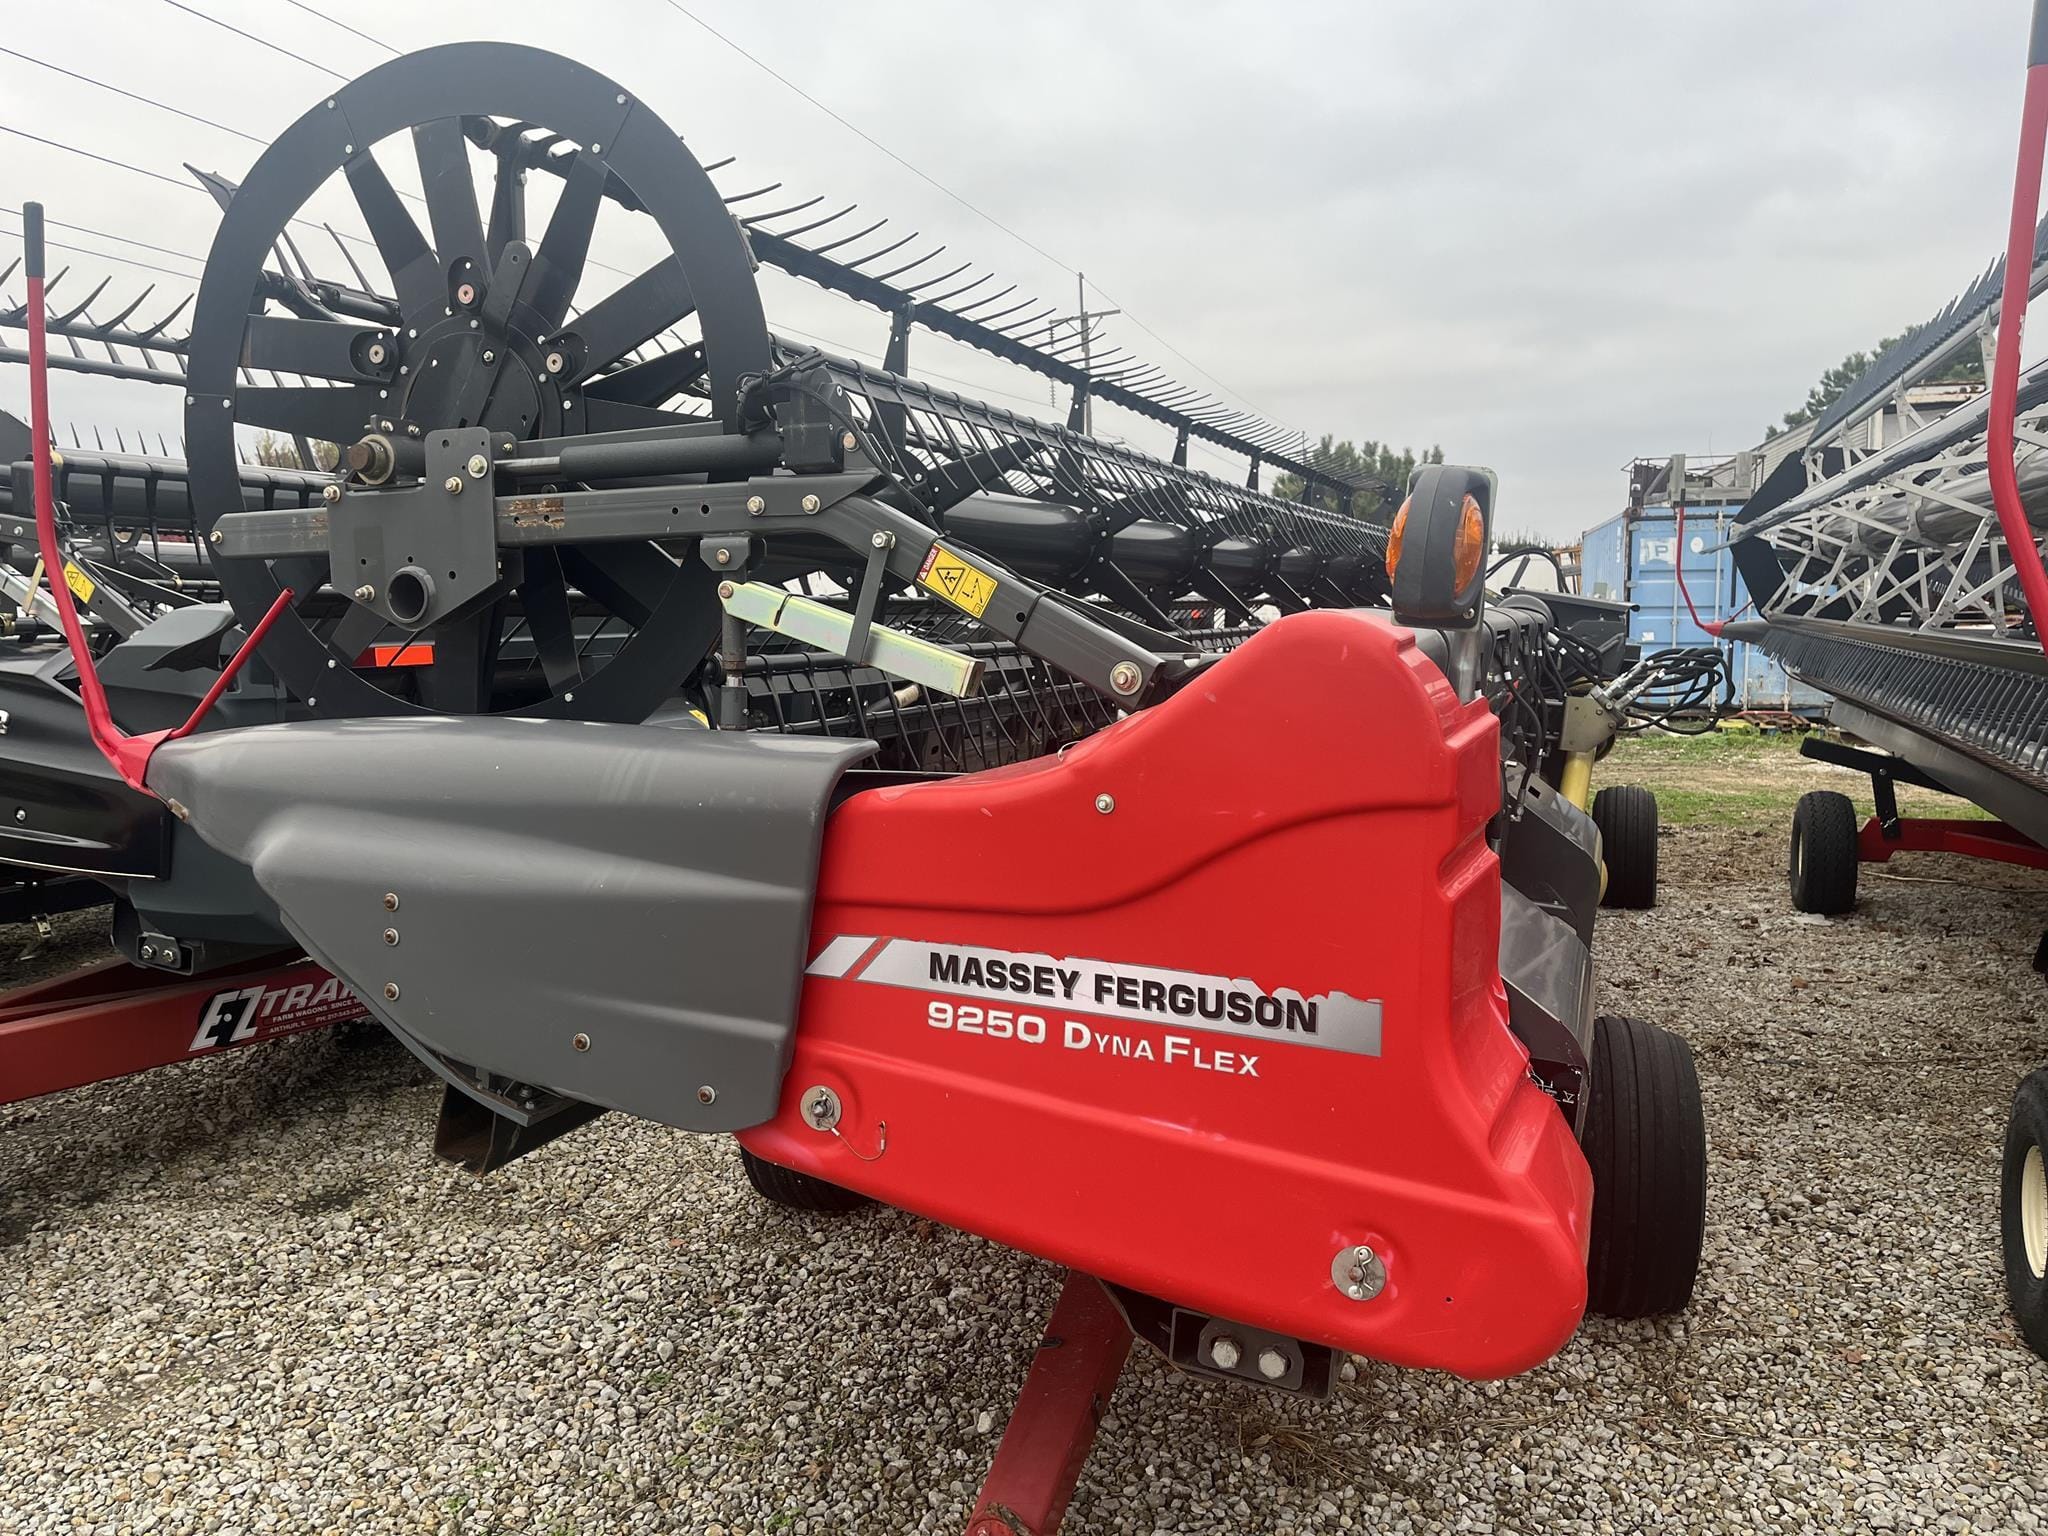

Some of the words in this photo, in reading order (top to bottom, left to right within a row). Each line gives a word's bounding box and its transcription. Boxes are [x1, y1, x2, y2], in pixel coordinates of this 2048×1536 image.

[272, 1012, 294, 1023] FARM
[295, 1005, 328, 1017] WAGONS
[331, 999, 352, 1009] SINCE
[929, 951, 1082, 1000] MASSEY
[1094, 973, 1319, 1036] FERGUSON
[927, 1001, 1047, 1044] 9250
